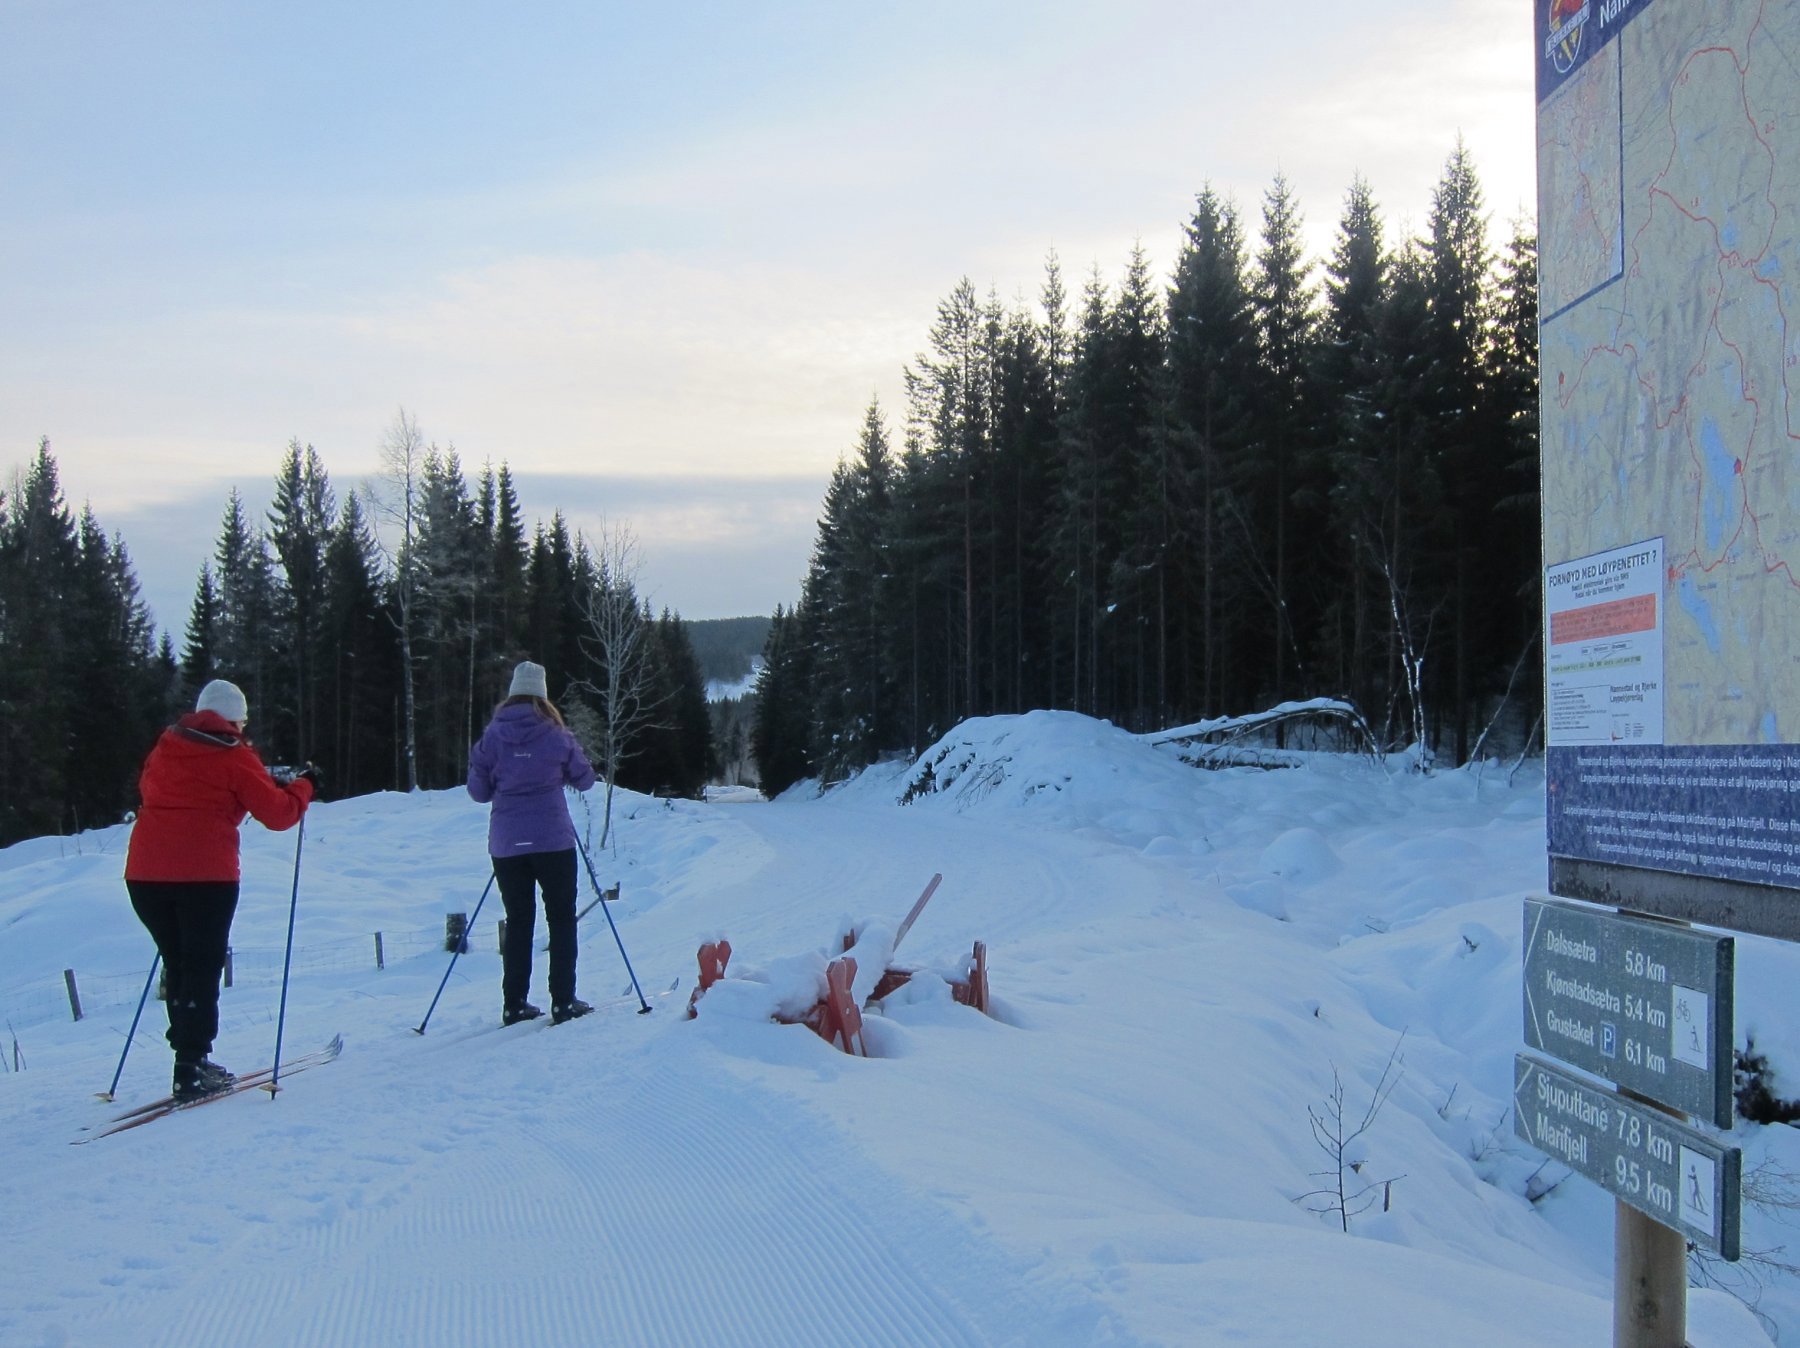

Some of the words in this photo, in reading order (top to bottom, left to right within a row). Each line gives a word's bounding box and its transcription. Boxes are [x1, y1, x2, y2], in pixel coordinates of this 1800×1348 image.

[1549, 571, 1580, 587] FORNØYD
[1582, 565, 1596, 580] MED
[1598, 551, 1651, 576] LØYPENETTET
[1729, 754, 1738, 770] på
[1738, 754, 1772, 768] Nordåsen
[1772, 758, 1782, 771] og
[1677, 776, 1685, 789] og
[1719, 777, 1727, 788] av
[1727, 776, 1735, 788] at
[1717, 817, 1726, 830] og
[1727, 815, 1736, 830] på
[1768, 818, 1789, 831] Disse
[1682, 831, 1697, 845] også
[1737, 835, 1783, 852] facebookside
[1783, 844, 1793, 856] og
[1771, 863, 1781, 876] og
[1546, 930, 1597, 963] Dalssætra
[1625, 950, 1644, 977] 5,8
[1646, 955, 1666, 983] km
[1546, 969, 1621, 1014] Kjønstadsætra
[1625, 994, 1643, 1021] 5,4
[1646, 1001, 1666, 1029] km
[1547, 1009, 1594, 1047] Grustaket
[1603, 1028, 1612, 1050] P
[1625, 1038, 1641, 1065] 6,1
[1646, 1045, 1666, 1075] km
[1537, 1072, 1609, 1132] Sjuputtane
[1616, 1109, 1641, 1148] 7,8
[1647, 1123, 1673, 1165] km
[1537, 1112, 1587, 1164] Marifjell
[1615, 1154, 1640, 1194] 9,5
[1647, 1170, 1672, 1213] km
